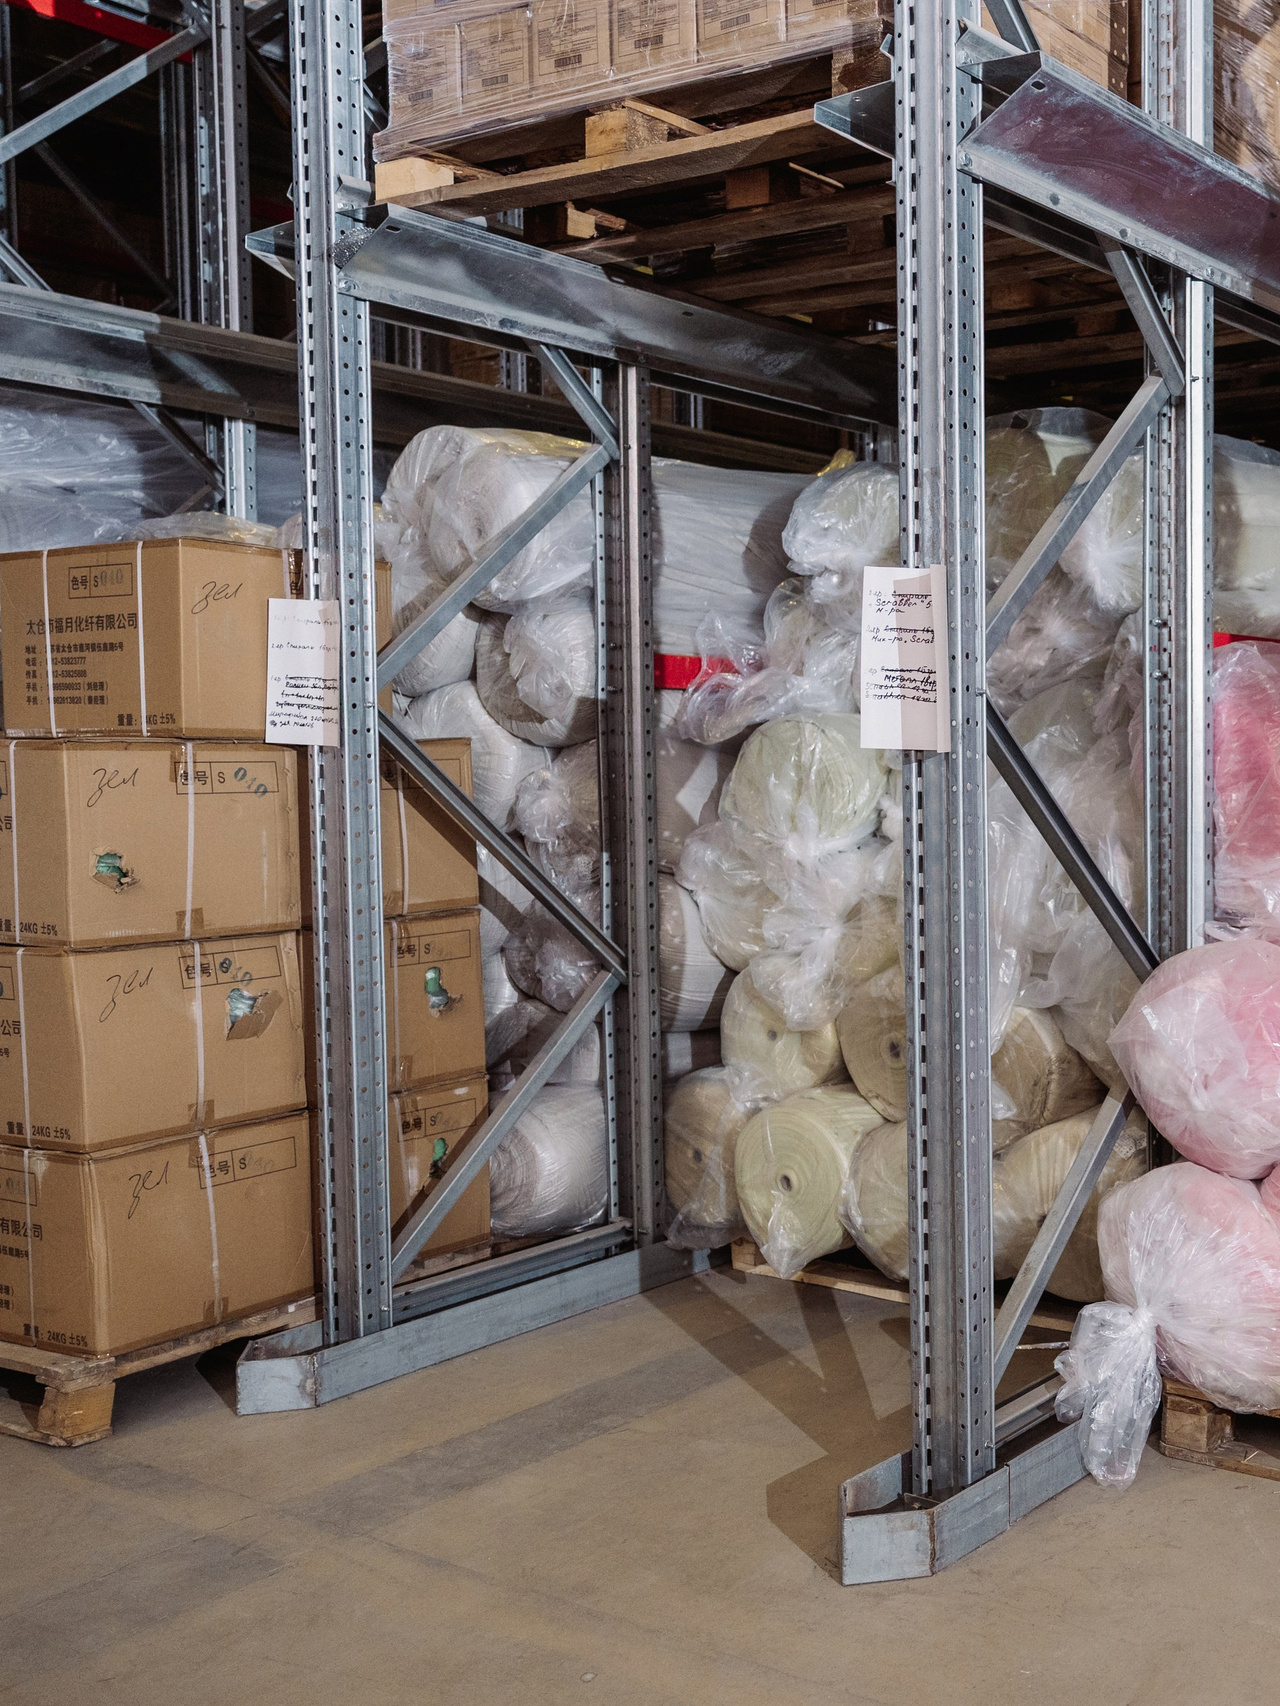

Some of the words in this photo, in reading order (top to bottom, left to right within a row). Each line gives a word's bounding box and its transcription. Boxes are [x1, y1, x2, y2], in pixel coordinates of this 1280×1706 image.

[71, 575, 89, 590] 色号
[217, 771, 226, 784] S
[423, 943, 431, 955] S
[429, 1115, 437, 1127] S
[239, 1157, 247, 1170] S
